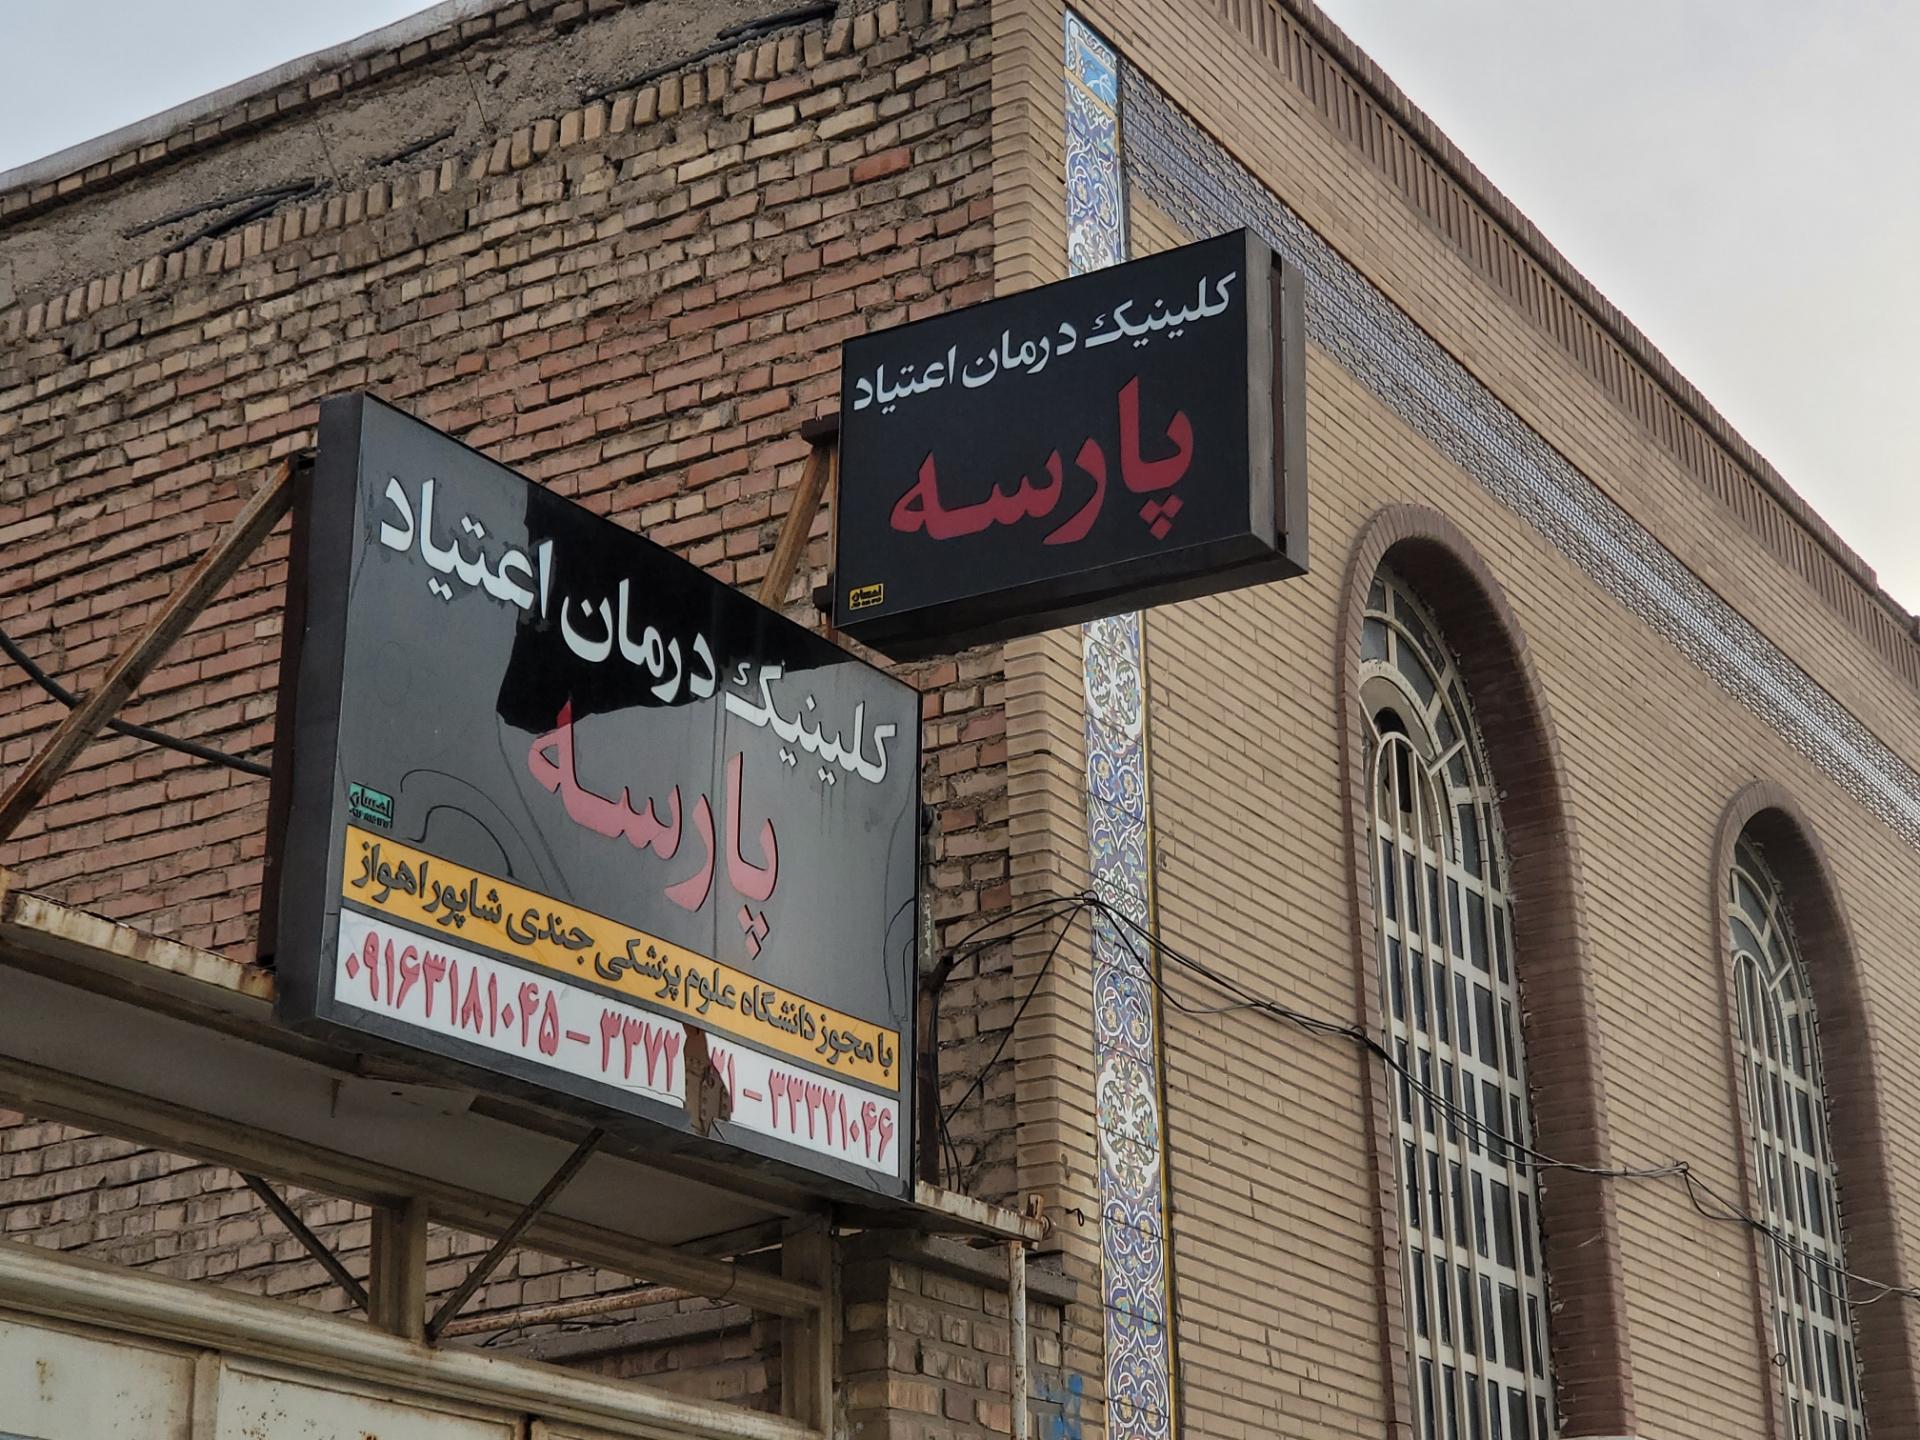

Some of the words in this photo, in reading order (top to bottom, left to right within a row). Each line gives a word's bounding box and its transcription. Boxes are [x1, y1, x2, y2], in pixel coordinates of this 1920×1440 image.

[853, 345, 957, 415] اعتیاد
[962, 322, 1077, 388] درمان
[890, 375, 1194, 545] پارسه
[380, 476, 554, 620] اعتیاد
[560, 578, 717, 704] درمان
[528, 700, 779, 960] پارسه
[351, 841, 429, 904] اهواز
[422, 878, 503, 930] شاپور
[505, 907, 595, 966] جندی
[594, 938, 683, 1002] پزشکی
[684, 967, 737, 1016] علوم
[740, 984, 817, 1043] دانشگاه
[814, 1013, 875, 1066] مجوز
[345, 931, 561, 1057] ۰۹۱۶۳۱۸۱۰۴۵
[768, 1067, 894, 1163] ۳۳۳۲۱۰۴۶
[878, 1032, 894, 1077] با
